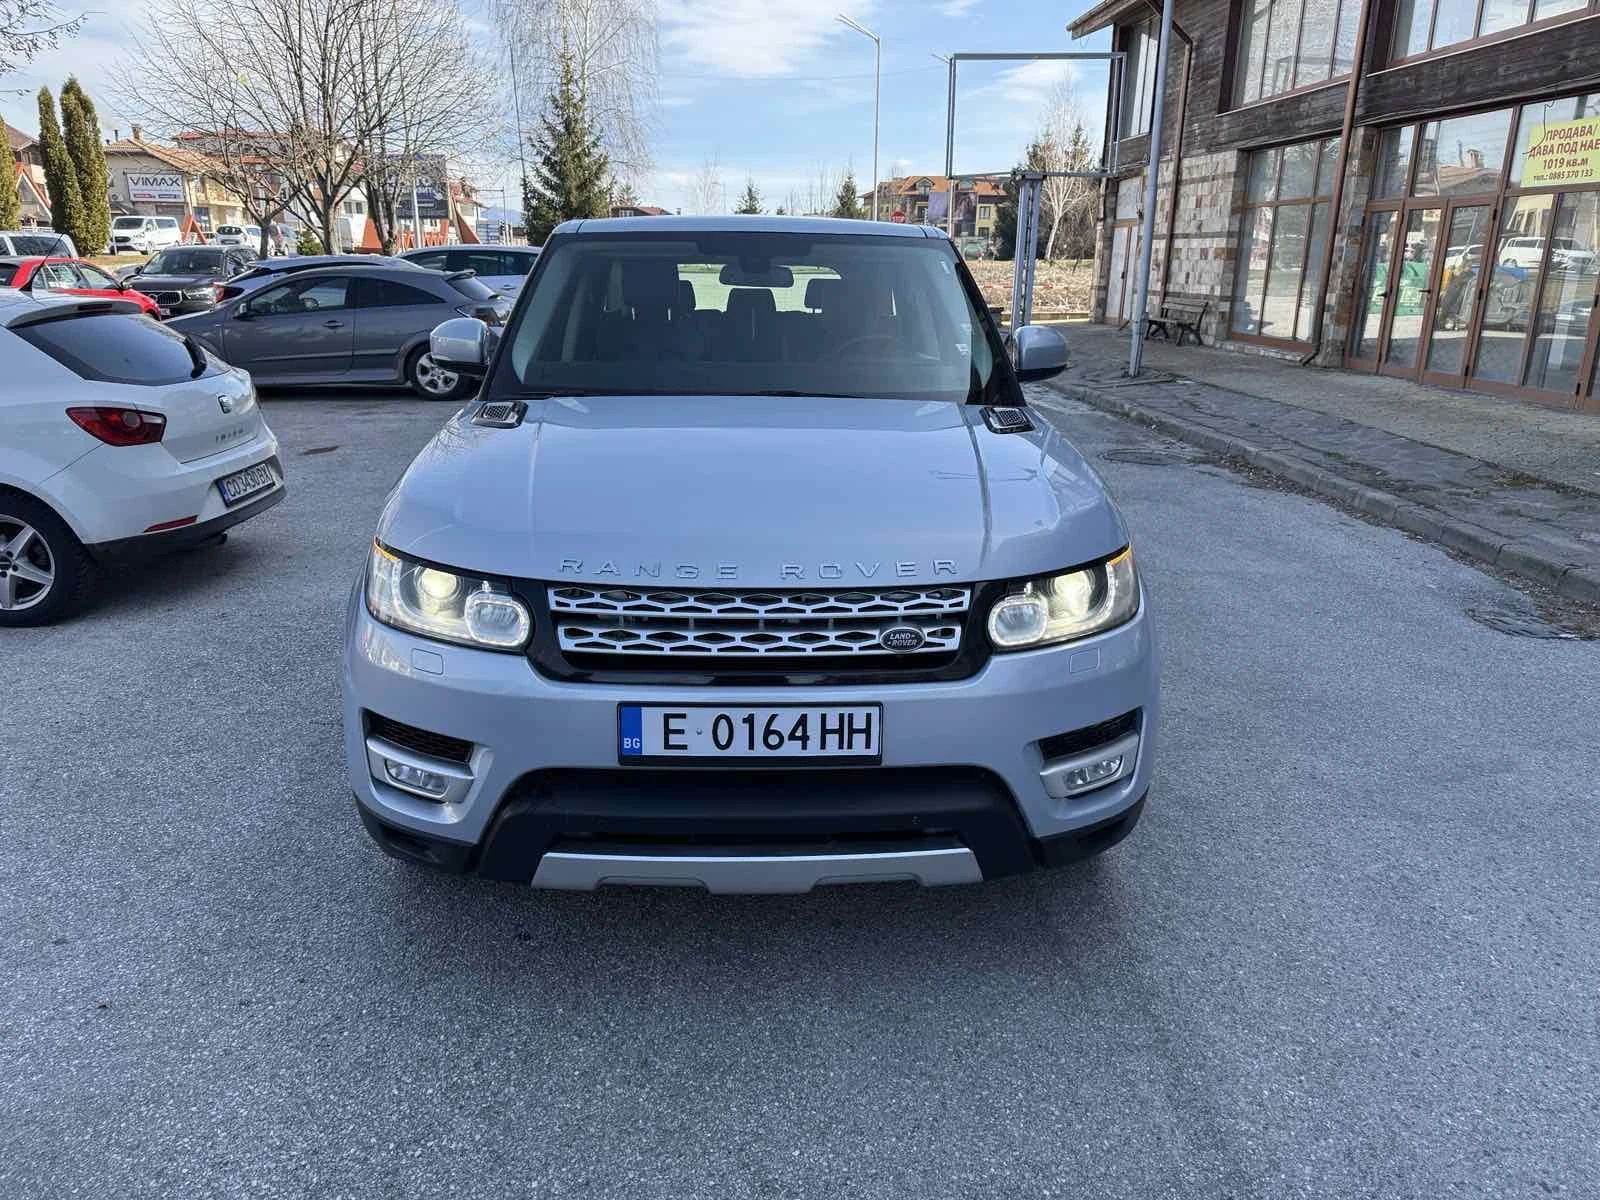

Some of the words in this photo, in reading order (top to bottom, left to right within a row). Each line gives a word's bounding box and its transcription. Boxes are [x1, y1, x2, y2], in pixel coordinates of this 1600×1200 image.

[1529, 144, 1555, 158] ДАВА
[1556, 141, 1578, 155] ПОД
[1543, 158, 1565, 169] 1019
[129, 176, 181, 187] VIMAX
[559, 558, 739, 581] RANGE
[780, 558, 958, 581] ROVER
[889, 632, 911, 640] LAND
[891, 639, 918, 647] ROVER
[663, 712, 689, 751] E
[623, 737, 641, 749] BG
